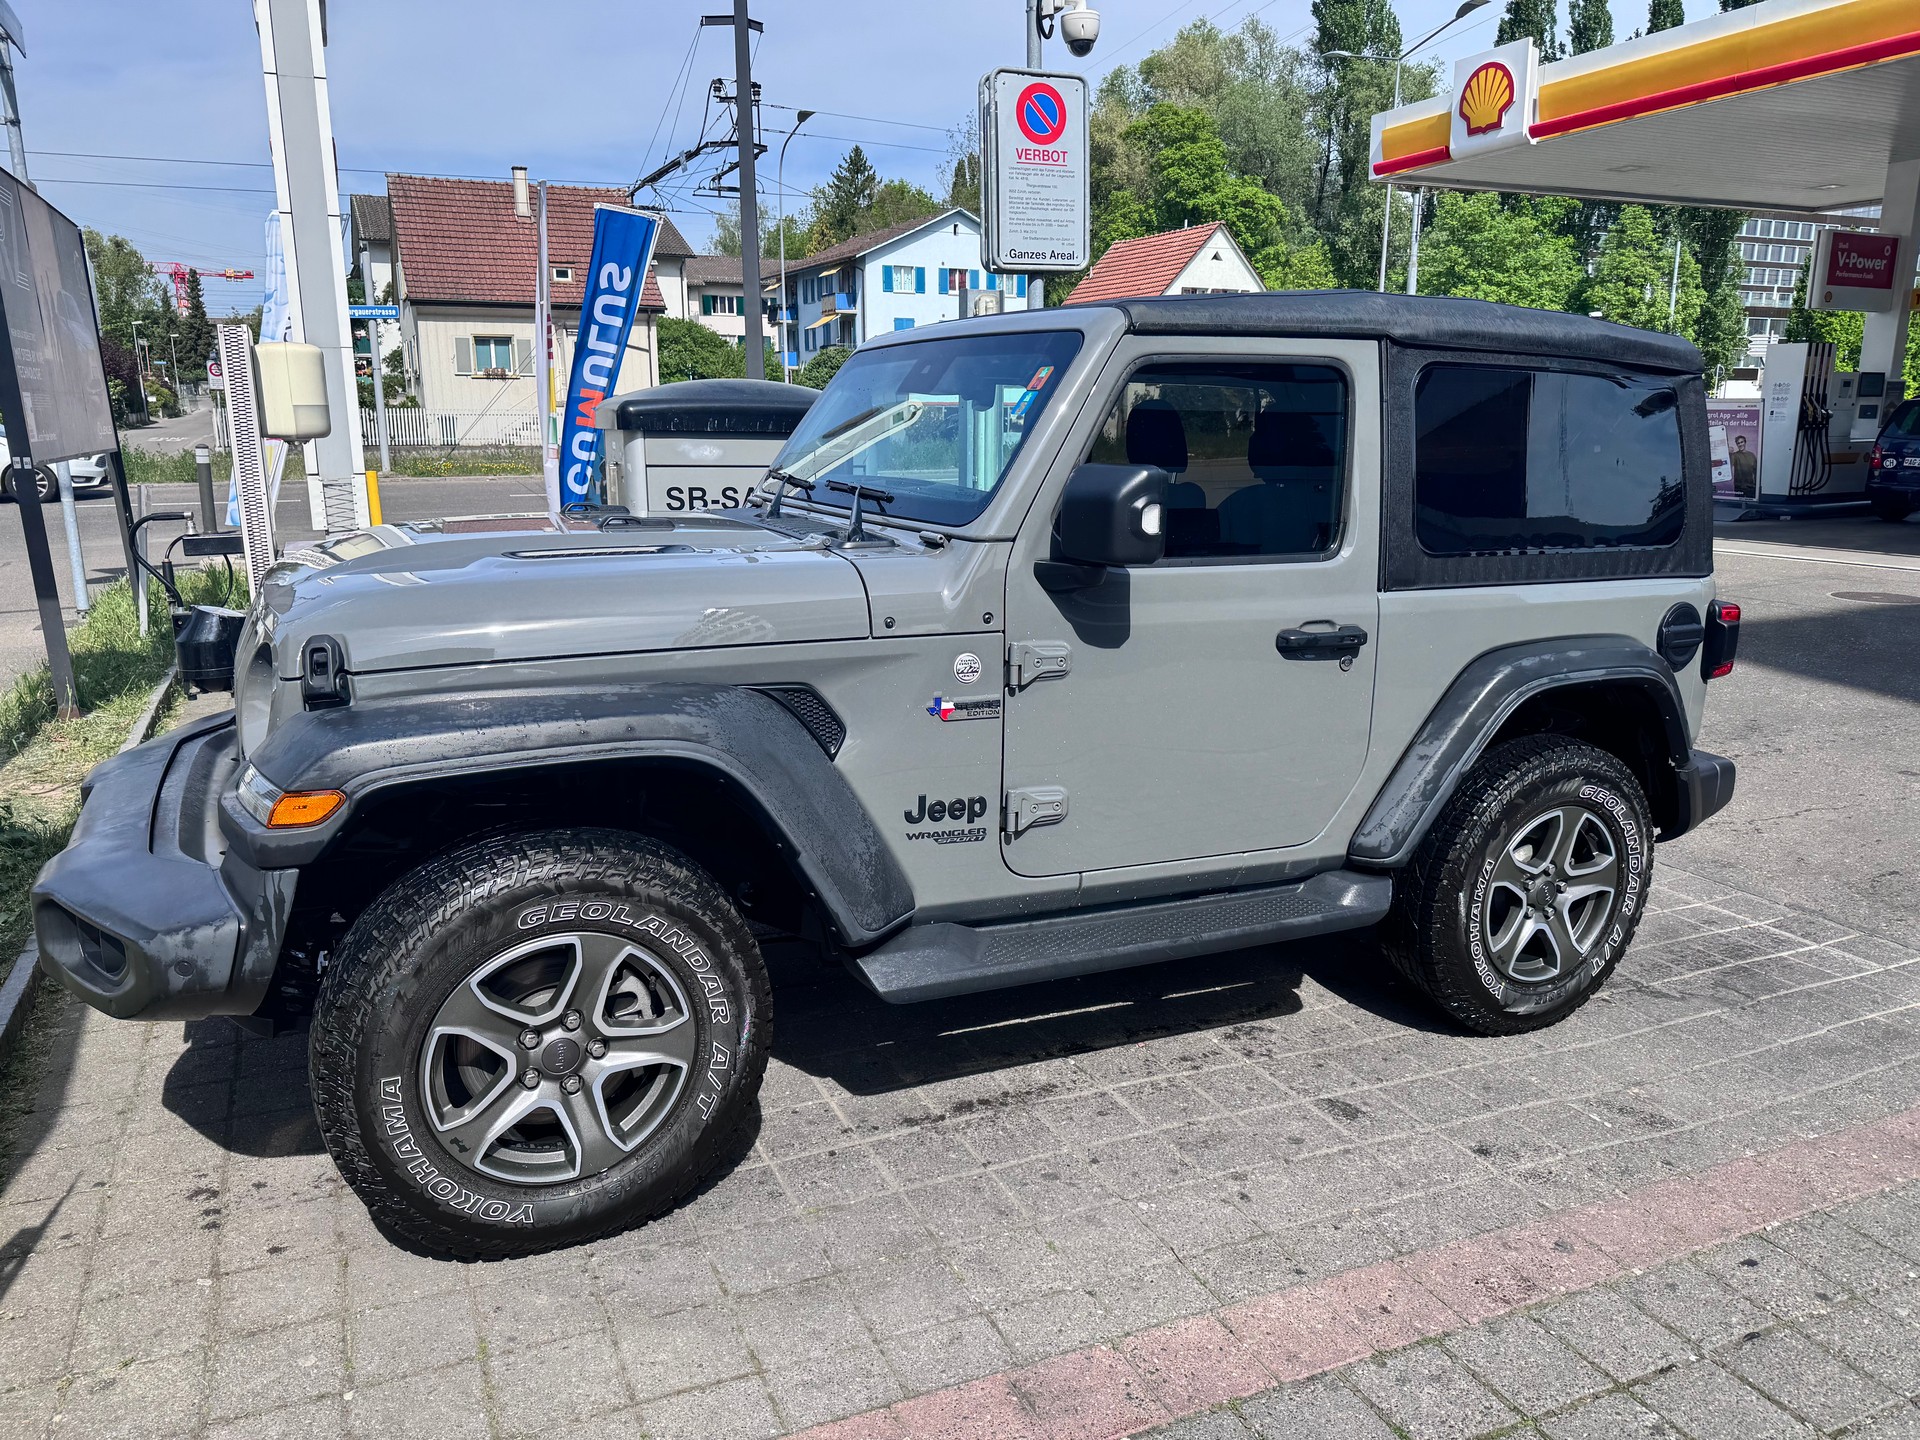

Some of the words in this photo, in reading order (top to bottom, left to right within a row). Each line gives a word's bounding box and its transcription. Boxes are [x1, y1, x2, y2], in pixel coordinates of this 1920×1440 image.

[1015, 147, 1068, 163] VERBOT
[1009, 248, 1047, 260] Ganzes
[1049, 249, 1075, 261] Areal
[1837, 251, 1888, 271] V-Power
[1720, 411, 1731, 420] App
[966, 708, 1000, 717] EDITION
[904, 793, 987, 825] Jeep
[905, 827, 987, 841] WRANGLER
[936, 834, 984, 844] SPORT
[1579, 785, 1641, 916] GEOLANDAR
[1470, 858, 1504, 999] YOKOHAMA
[1591, 923, 1623, 977] A/T
[517, 901, 730, 1025] GEOLANDAR
[697, 1040, 731, 1120] A/T
[380, 1076, 534, 1224] YOKOHAMA
